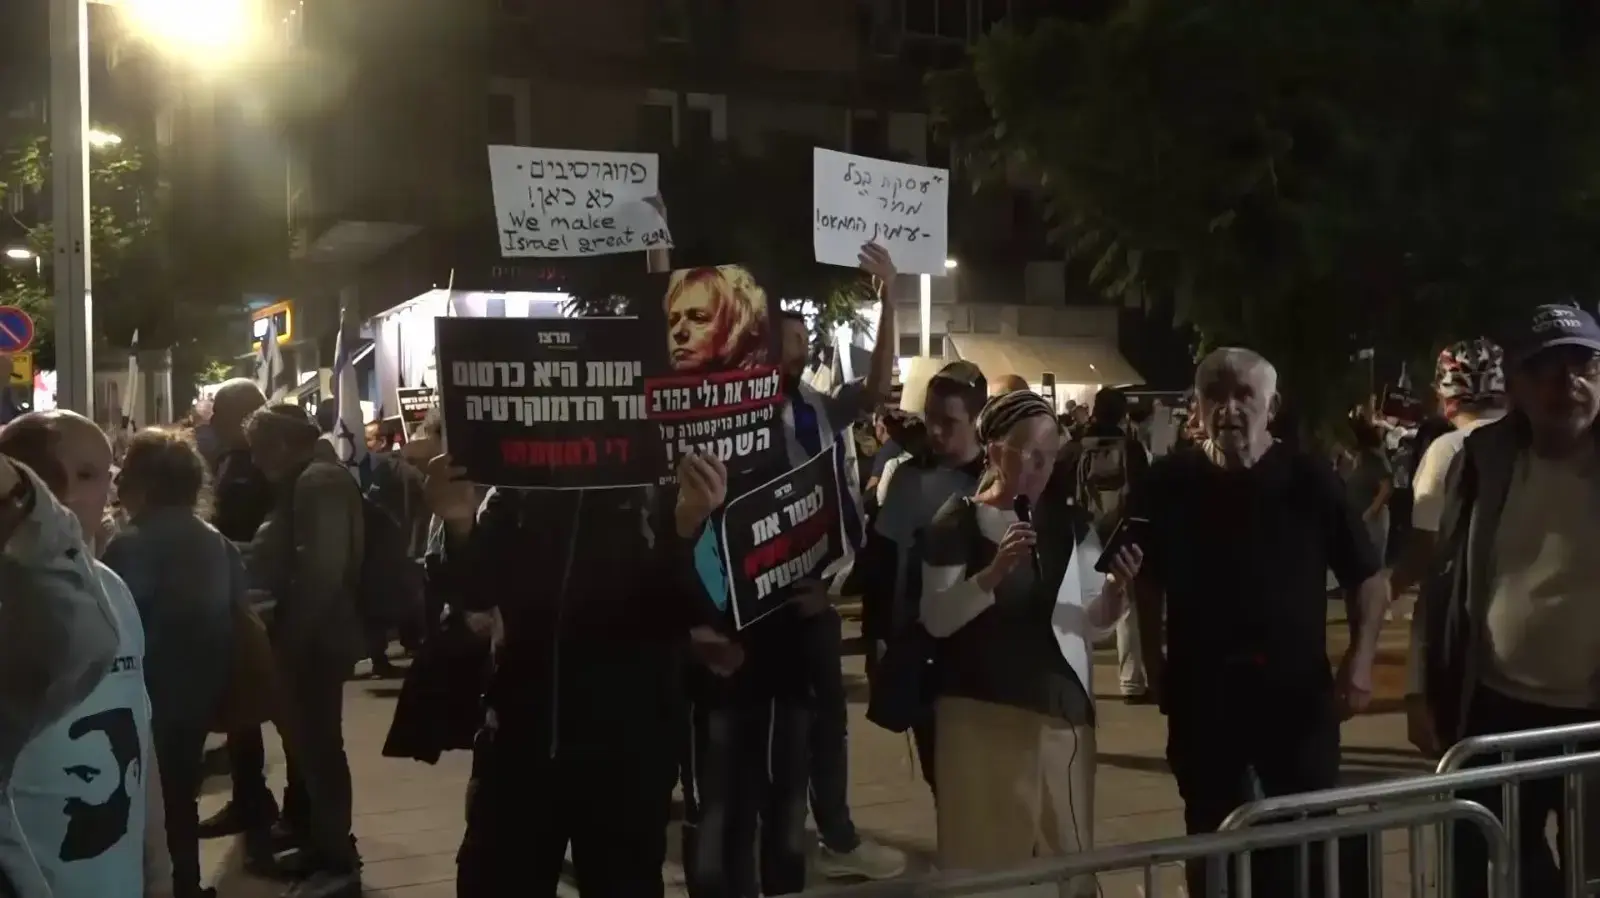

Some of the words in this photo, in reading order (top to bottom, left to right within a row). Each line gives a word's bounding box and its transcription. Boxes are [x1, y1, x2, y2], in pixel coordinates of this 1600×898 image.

[530, 159, 647, 184] פרוגרסיבים
[844, 162, 872, 187] בכל
[528, 186, 576, 215] כאן!
[586, 188, 614, 209] לא
[508, 211, 540, 231] We
[550, 213, 616, 231] make
[503, 229, 569, 252] Israel
[579, 226, 635, 254] great
[452, 361, 526, 388] כרסום
[532, 361, 578, 388] היא
[585, 361, 642, 388] ימות
[748, 369, 780, 397] לפטר
[652, 388, 691, 412] בהרב
[697, 379, 719, 408] גלי
[724, 381, 743, 405] את
[466, 395, 605, 427] הדמוקרטיה
[735, 412, 748, 428] את
[750, 404, 774, 424] לסיים
[659, 424, 675, 440] של
[783, 484, 824, 527] לפטר
[751, 511, 782, 547] את
[111, 655, 135, 673] תרצ
